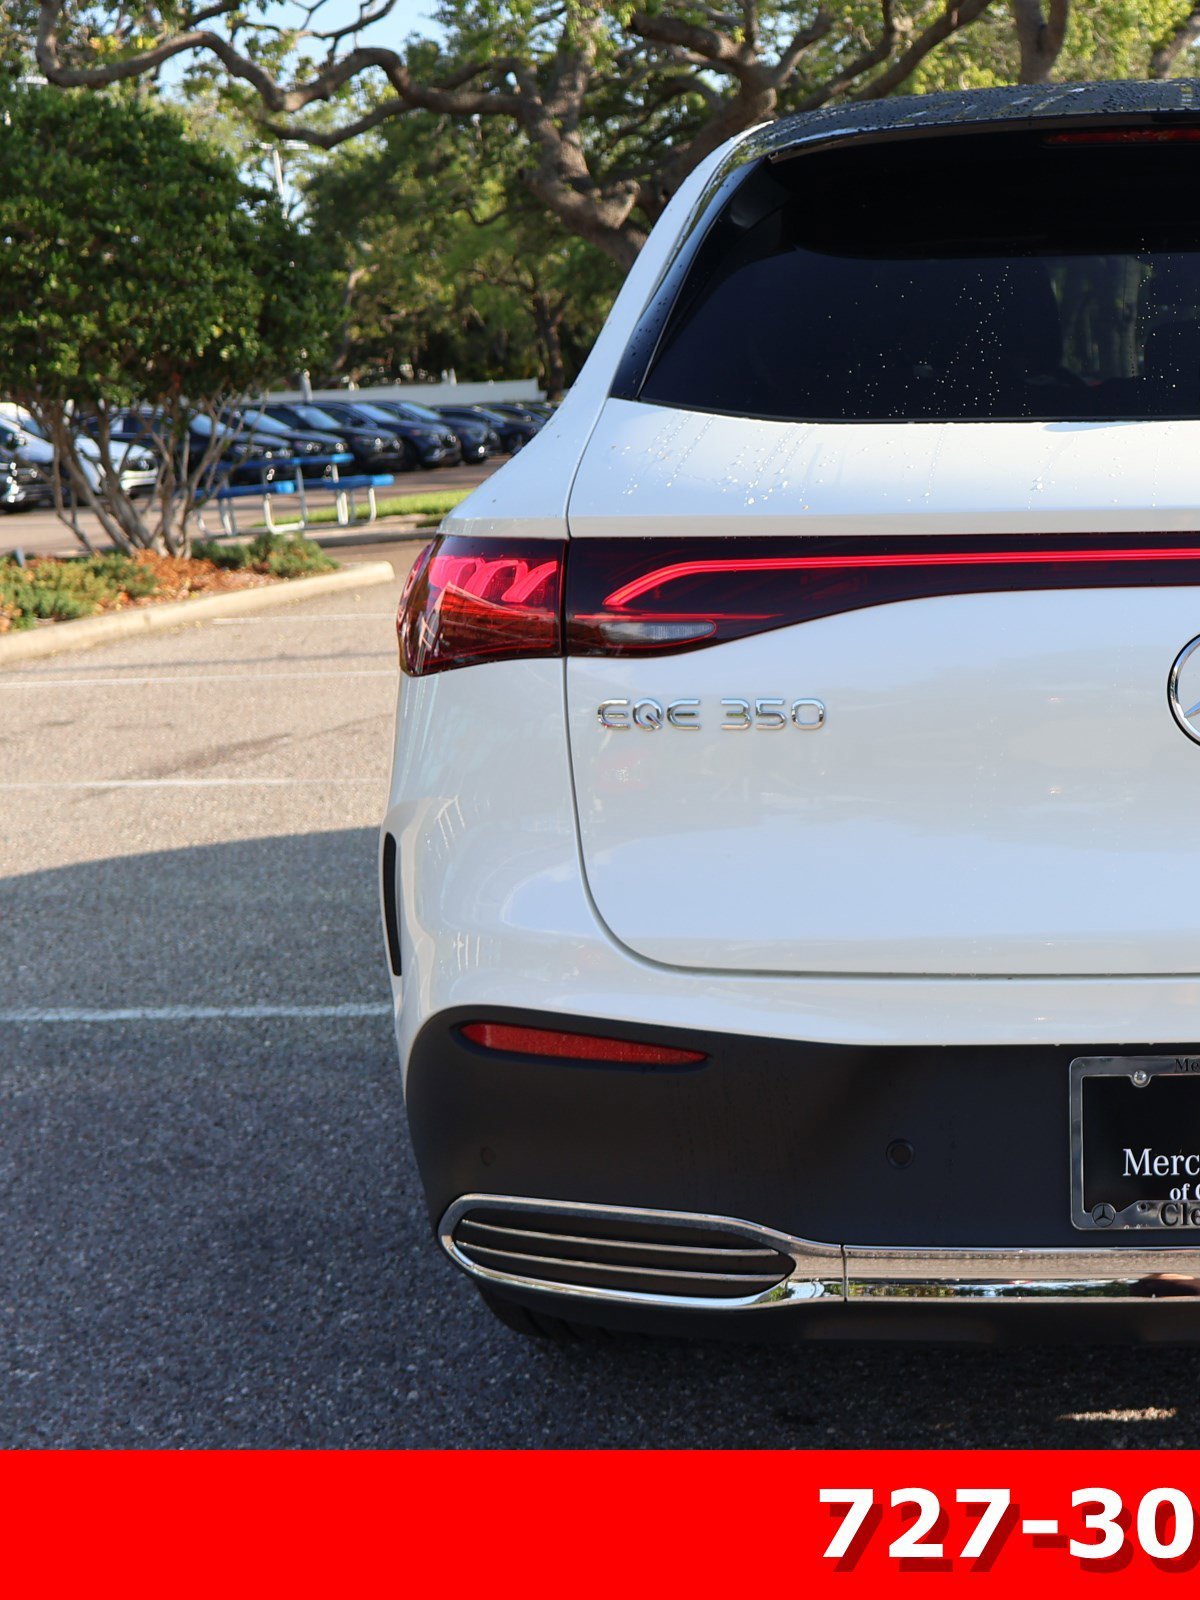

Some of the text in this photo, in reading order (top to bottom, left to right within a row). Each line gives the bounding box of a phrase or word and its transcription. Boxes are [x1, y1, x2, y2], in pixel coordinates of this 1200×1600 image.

[597, 699, 826, 730] EQE 350
[1169, 1184, 1189, 1201] of
